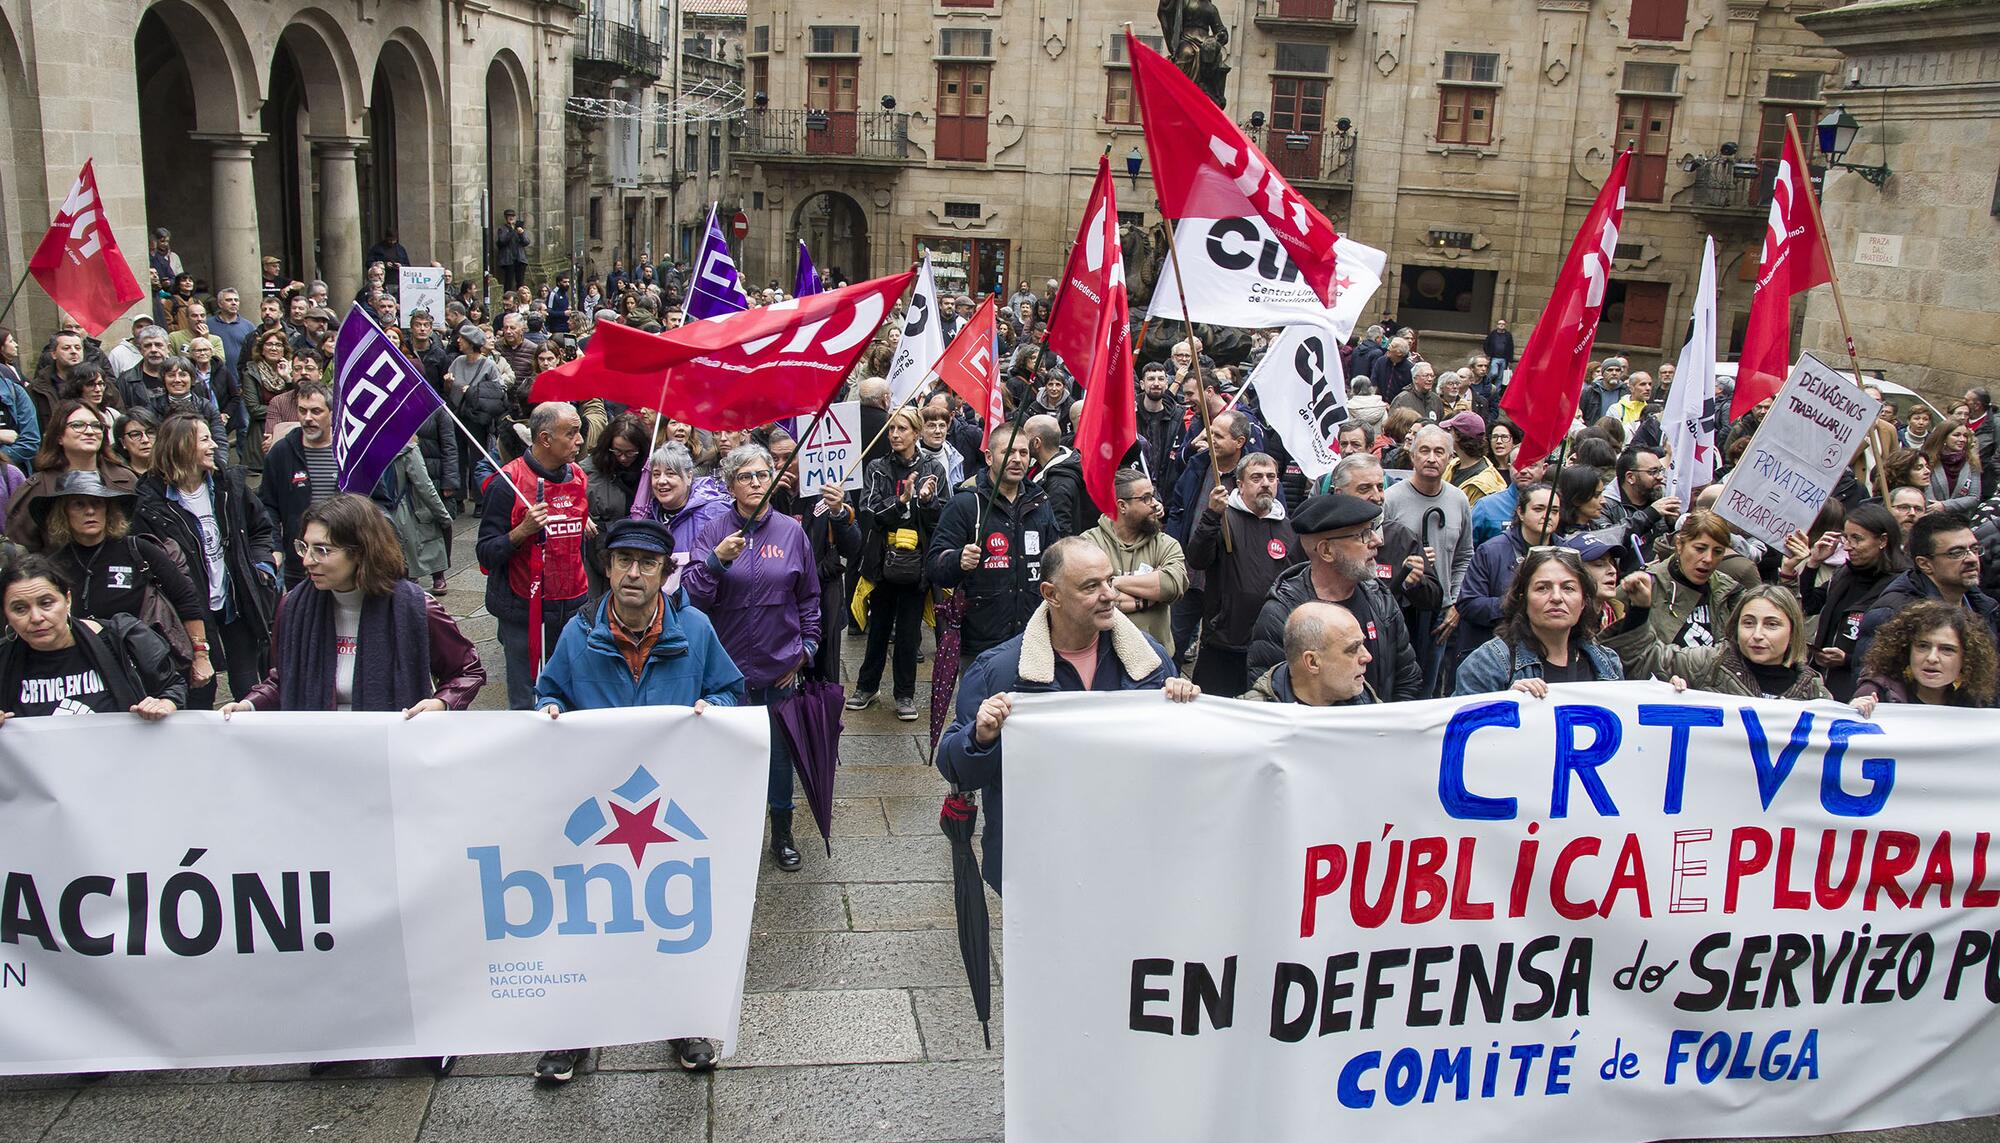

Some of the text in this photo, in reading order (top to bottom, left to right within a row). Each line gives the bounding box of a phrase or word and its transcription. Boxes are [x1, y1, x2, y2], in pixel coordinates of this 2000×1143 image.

[1869, 236, 1889, 246] PRAZA
[1251, 282, 1296, 297] Central
[1798, 371, 1867, 421] DEIXÁDENOS
[805, 447, 846, 464] TODO
[806, 464, 854, 487] MAL
[1753, 449, 1827, 513] PRIVATIZAR
[1728, 488, 1796, 539] PREVARICAR
[21, 677, 65, 704] CRTVG
[65, 674, 82, 697] EN
[1438, 700, 1898, 822] CRTVG
[1669, 828, 1713, 915] E
[1724, 826, 2000, 914] PLURAL
[0, 847, 335, 957] ACIÓN!
[466, 845, 713, 955] bng
[488, 961, 545, 974] BLOQUE
[490, 973, 588, 986] NACIONALISTA
[1130, 954, 1238, 1036] EN
[1270, 935, 1593, 1043] DEFENSA
[1612, 938, 1679, 994] do
[491, 987, 546, 999] GALEGO
[1599, 1036, 1641, 1081] de
[1664, 1028, 1820, 1087] FOLGA
